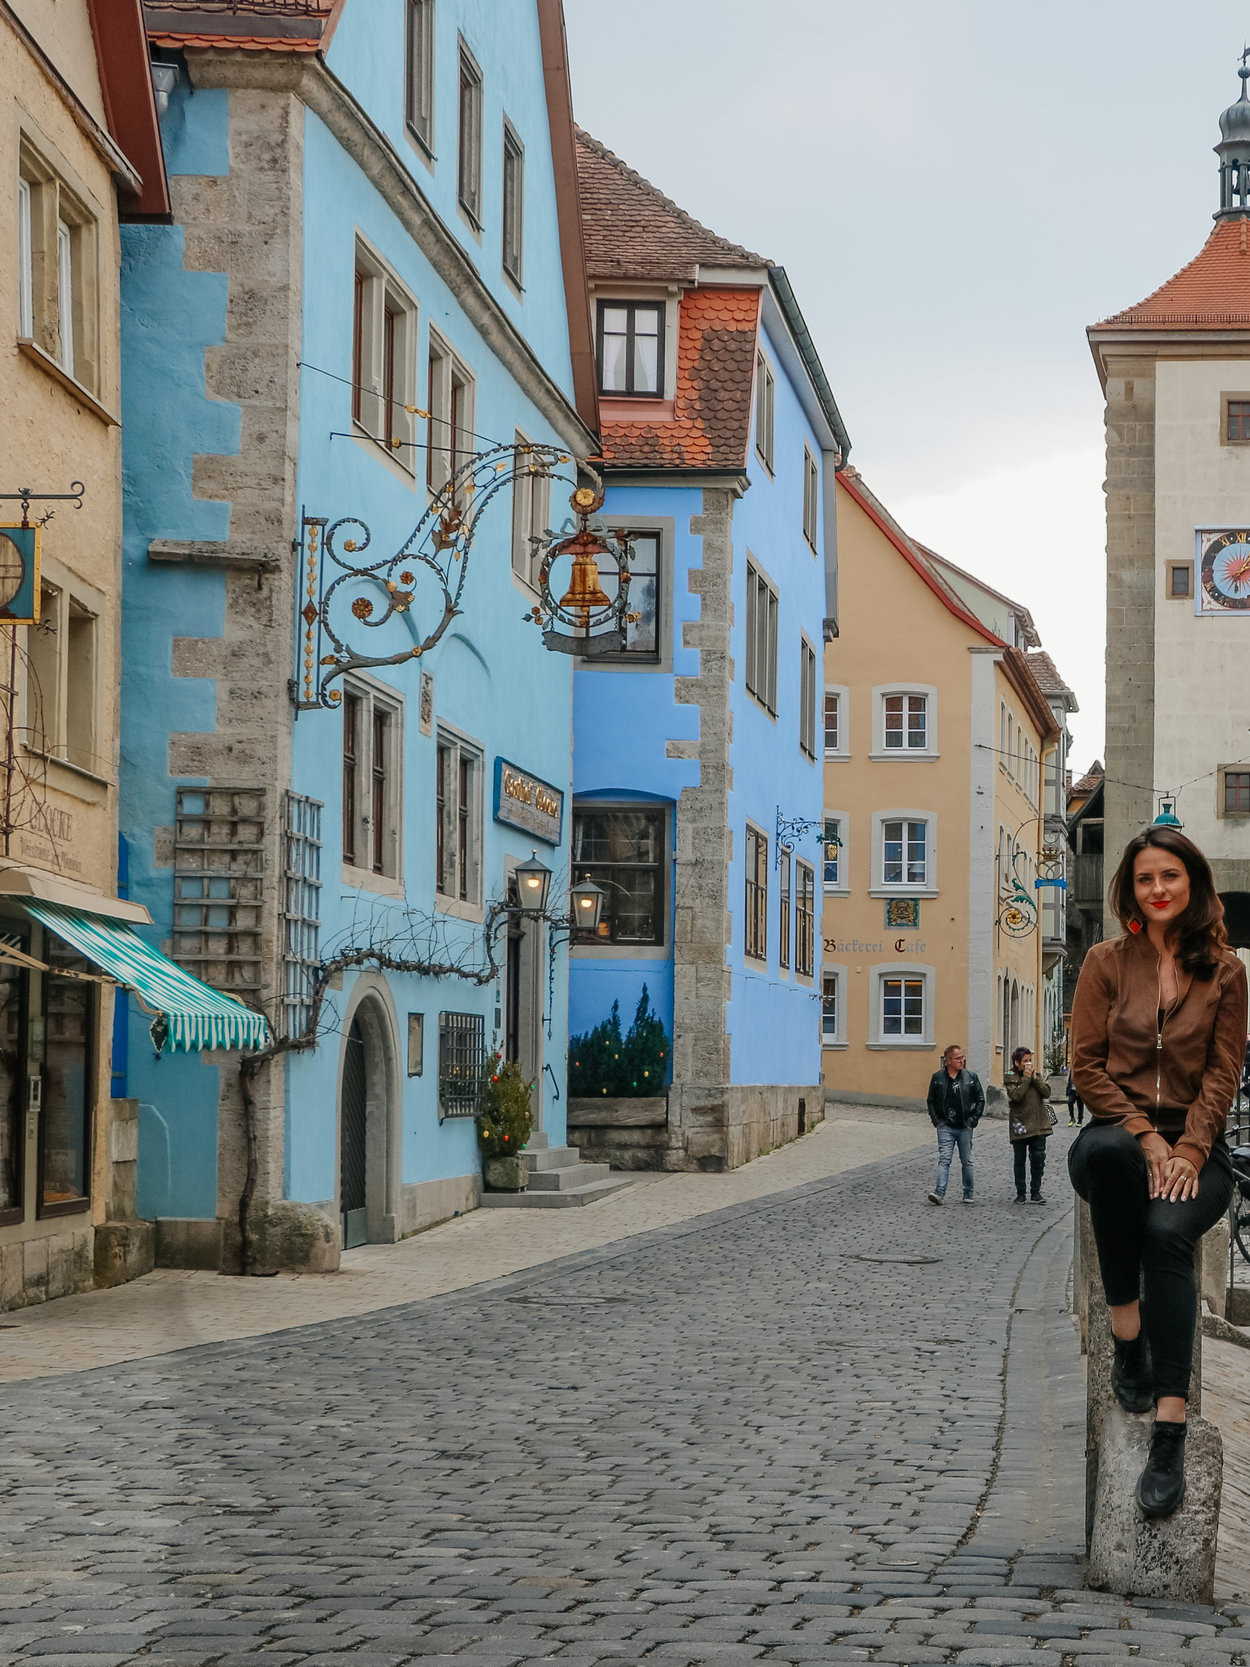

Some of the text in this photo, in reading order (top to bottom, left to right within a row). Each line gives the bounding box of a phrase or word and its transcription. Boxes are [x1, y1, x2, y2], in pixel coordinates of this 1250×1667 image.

[29, 799, 73, 842] GLOCKE
[823, 938, 927, 955] Bäckerei Cafe
